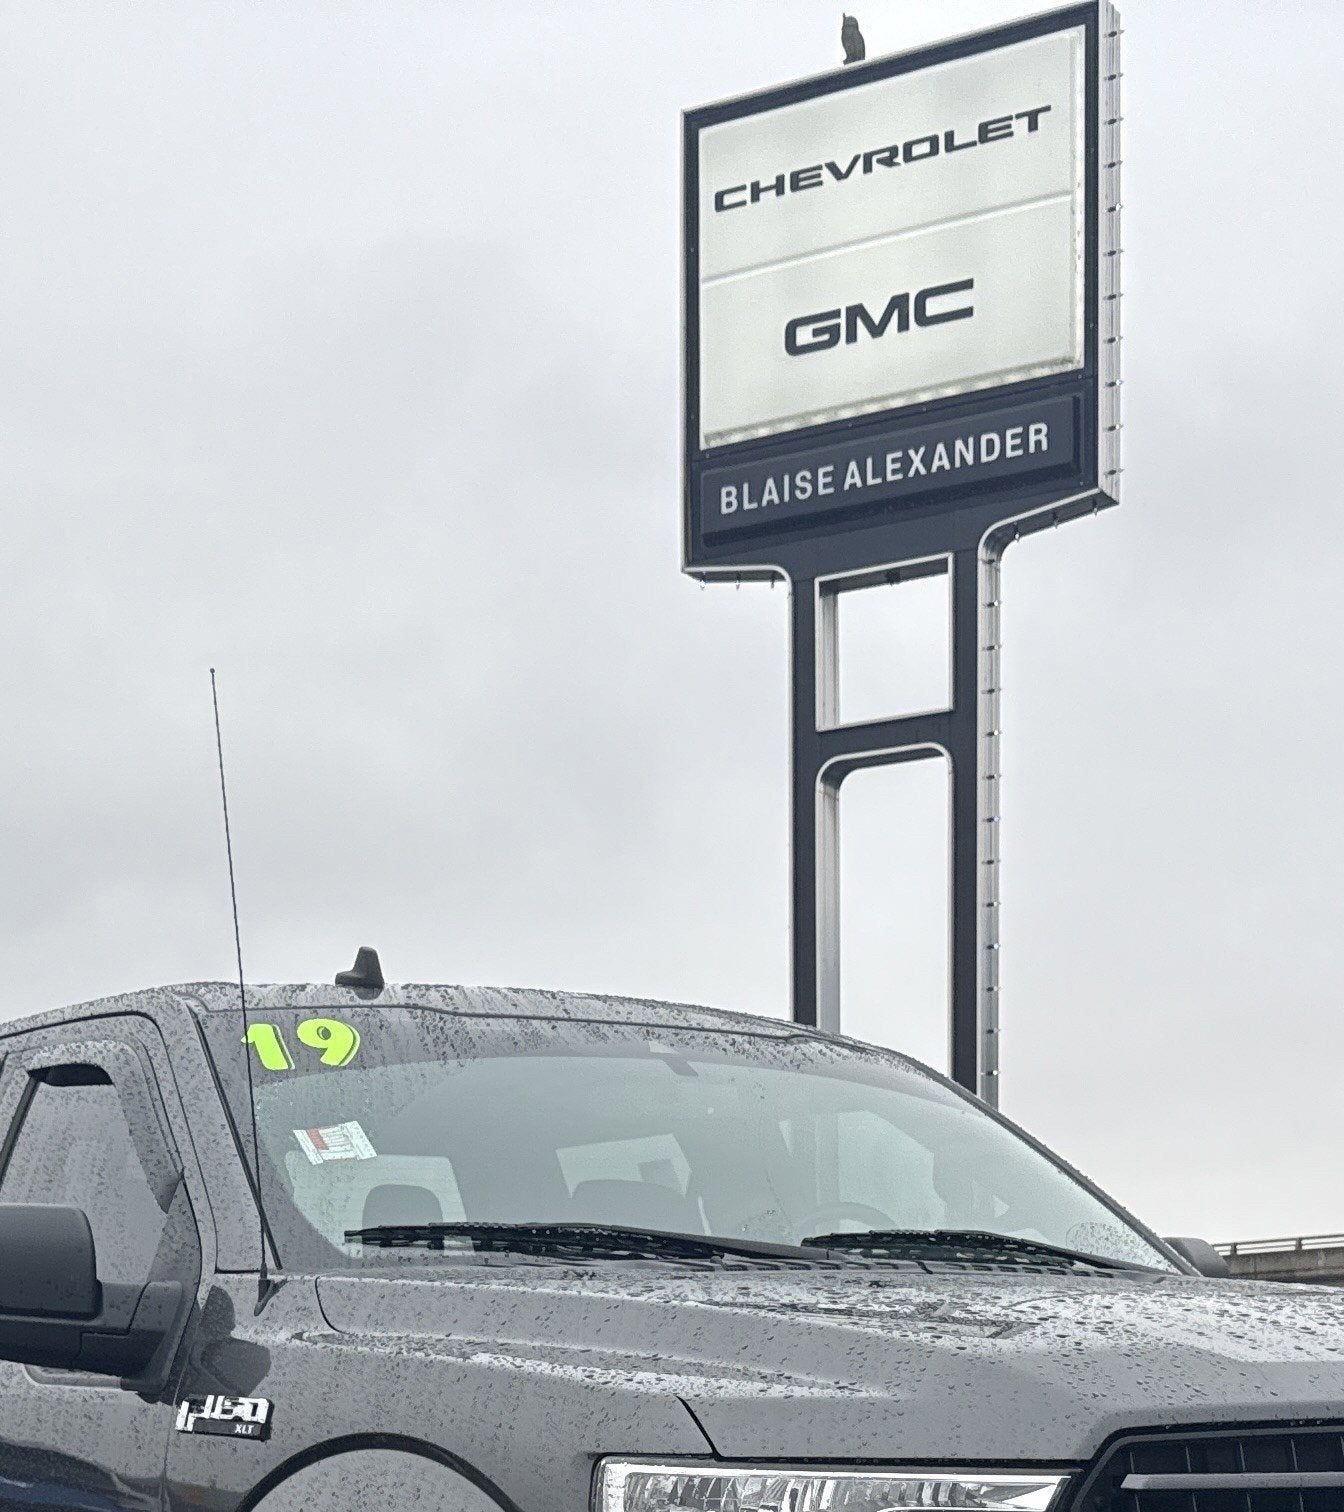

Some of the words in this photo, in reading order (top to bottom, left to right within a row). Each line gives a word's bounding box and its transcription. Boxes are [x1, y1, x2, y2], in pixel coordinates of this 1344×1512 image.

[714, 105, 1051, 213] CHEVROLET
[784, 277, 975, 357] GMC
[720, 465, 835, 515] BLAISE
[843, 422, 1049, 492] ALEXANDER
[241, 1018, 361, 1071] 19
[234, 1423, 255, 1435] XLT
